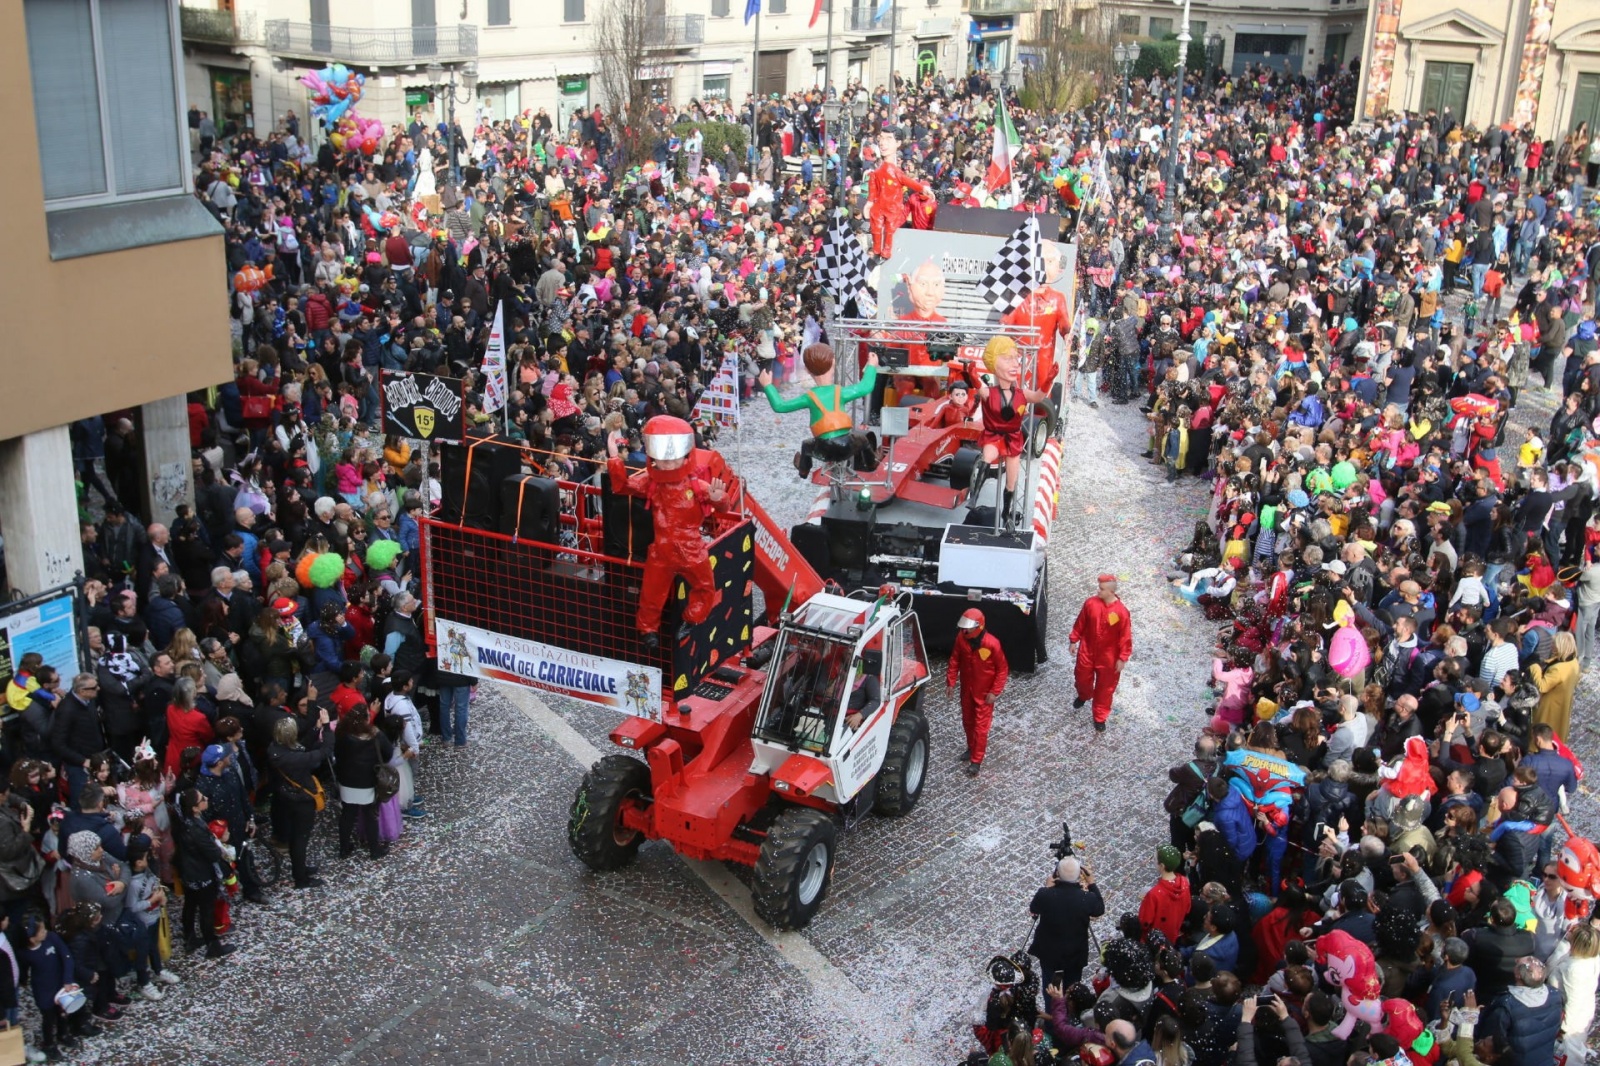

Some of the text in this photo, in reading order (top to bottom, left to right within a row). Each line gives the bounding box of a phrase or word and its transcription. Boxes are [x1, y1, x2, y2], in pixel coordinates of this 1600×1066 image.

[424, 377, 461, 420] CIRIMIDO
[495, 637, 598, 669] ASSOCIAZIONE
[477, 646, 618, 694] AMICI DEL CARNEVALE
[519, 677, 571, 696] CIRIMIDO
[1242, 755, 1289, 778] SPIDER-MAN
